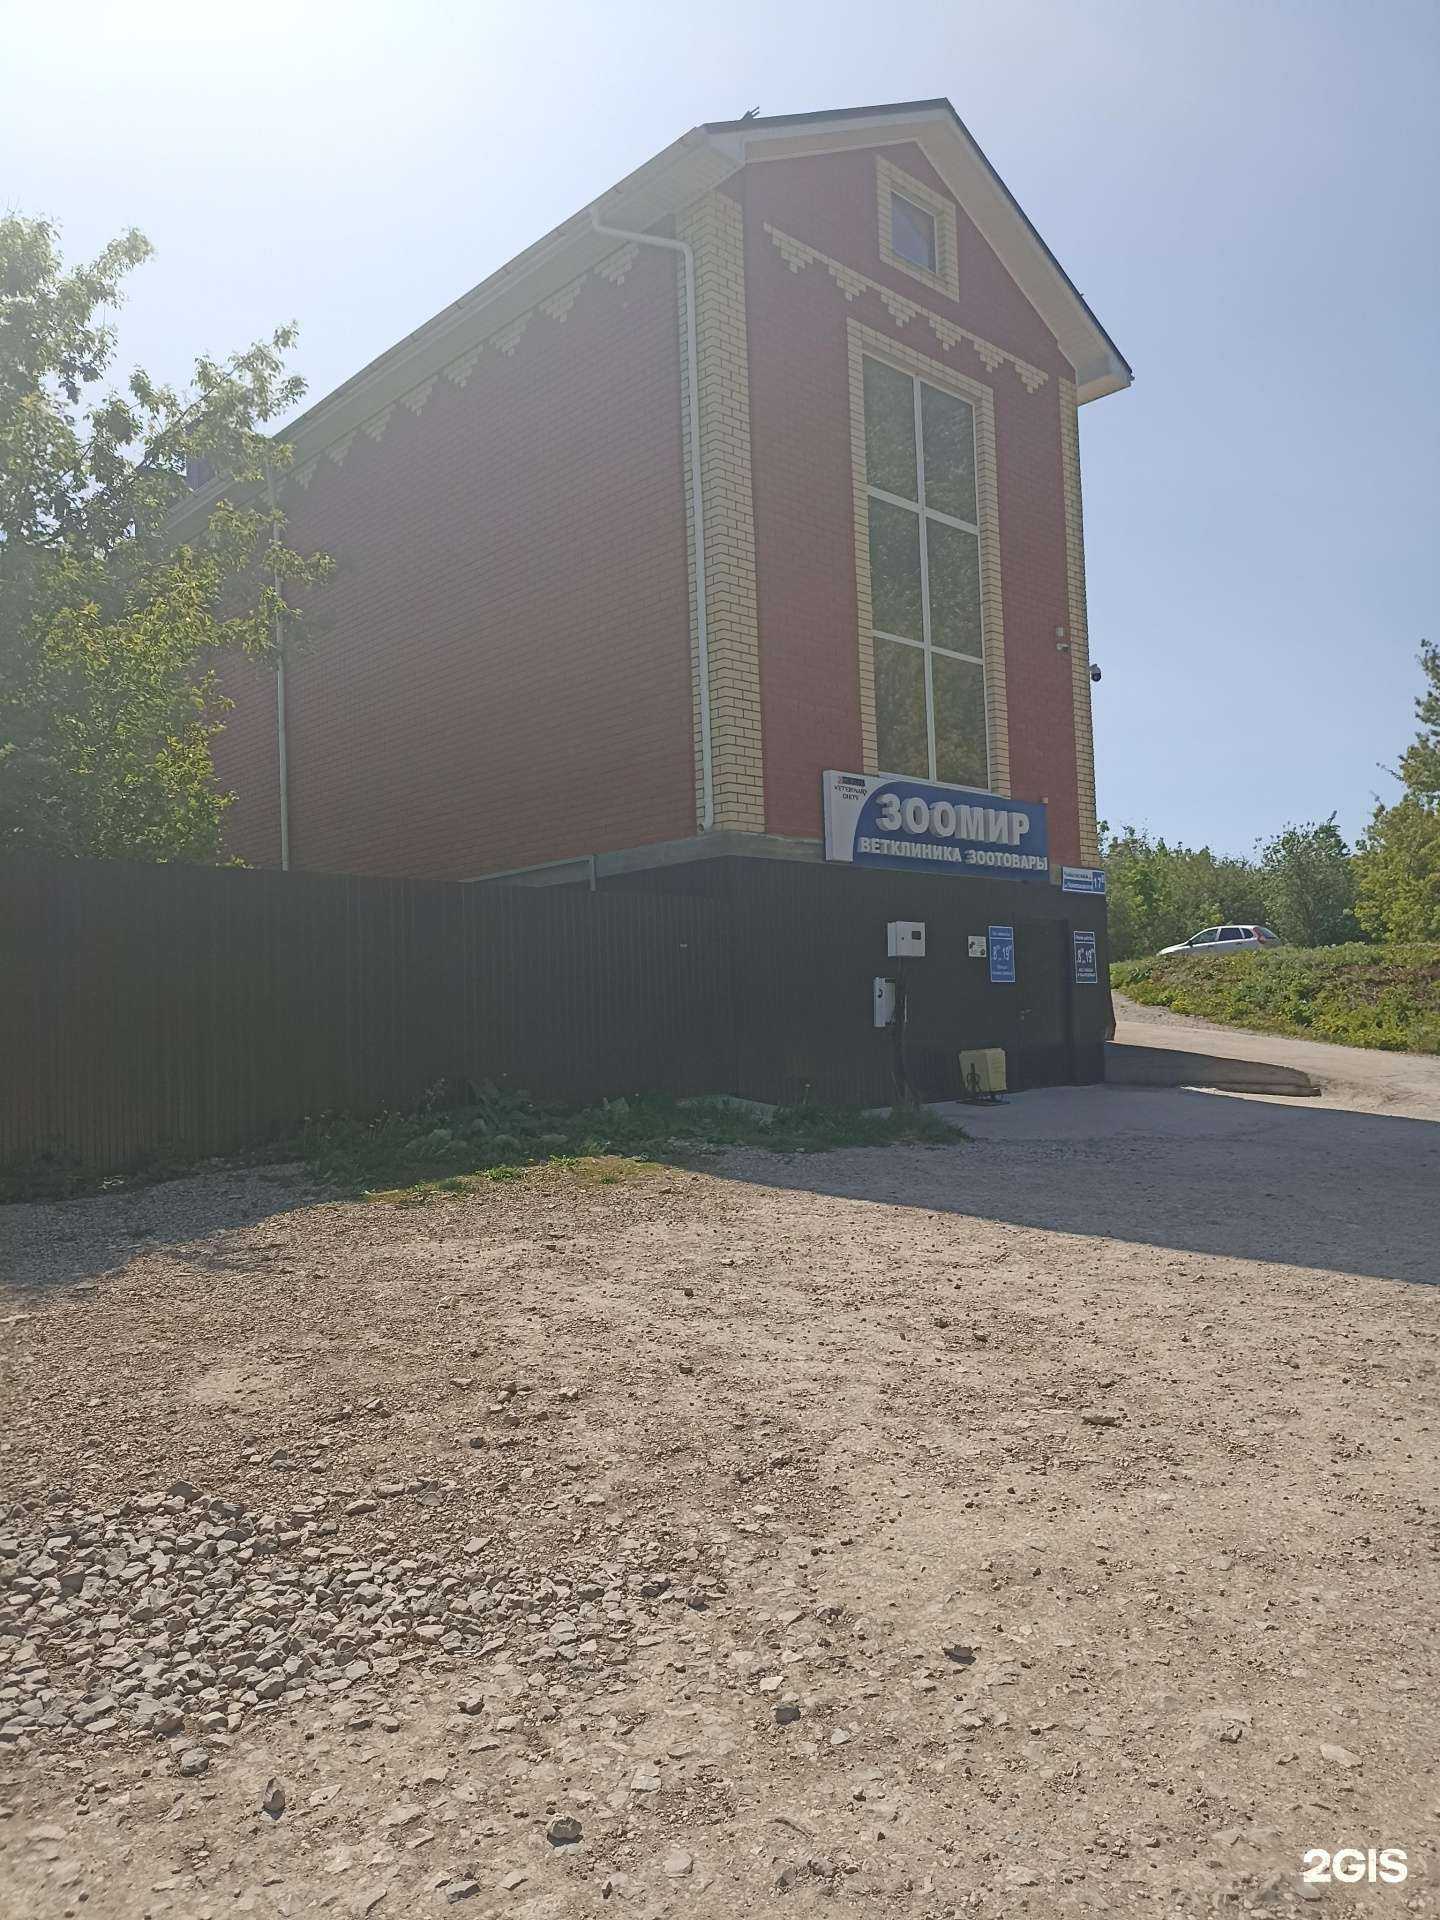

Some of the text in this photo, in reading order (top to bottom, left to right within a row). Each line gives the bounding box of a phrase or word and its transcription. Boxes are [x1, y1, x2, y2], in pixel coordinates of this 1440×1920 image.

[875, 793, 1030, 846] ЗООМИР
[859, 836, 1048, 871] ВЕТКЛИНИКА ЗООТОВАРЫ
